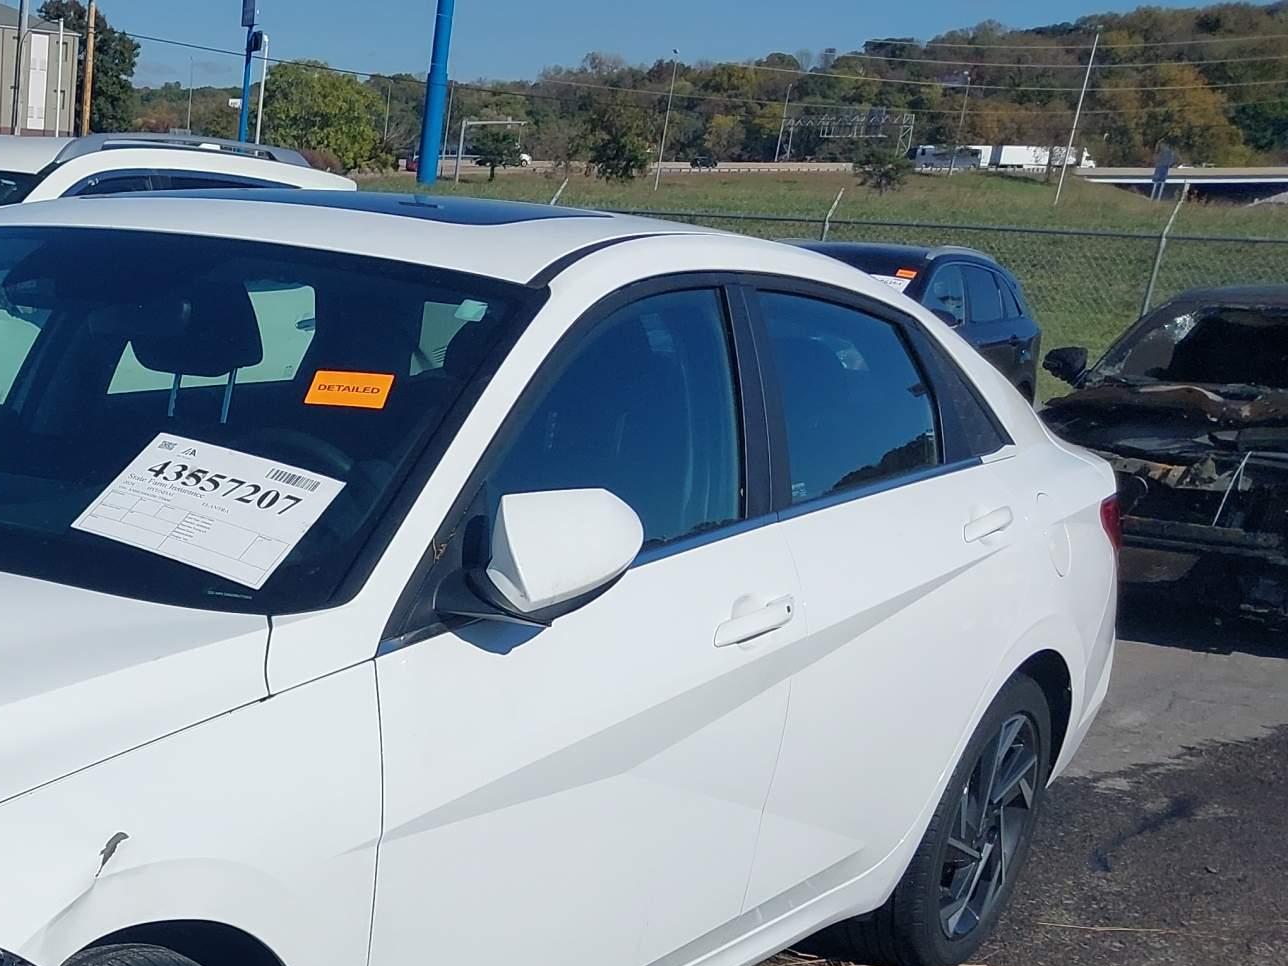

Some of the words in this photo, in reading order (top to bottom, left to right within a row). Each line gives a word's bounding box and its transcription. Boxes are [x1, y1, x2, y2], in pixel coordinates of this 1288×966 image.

[317, 384, 381, 394] DETAILED
[128, 473, 147, 482] State
[148, 477, 167, 488] Farm
[168, 484, 206, 499] Insurance
[147, 460, 304, 516] 43557207
